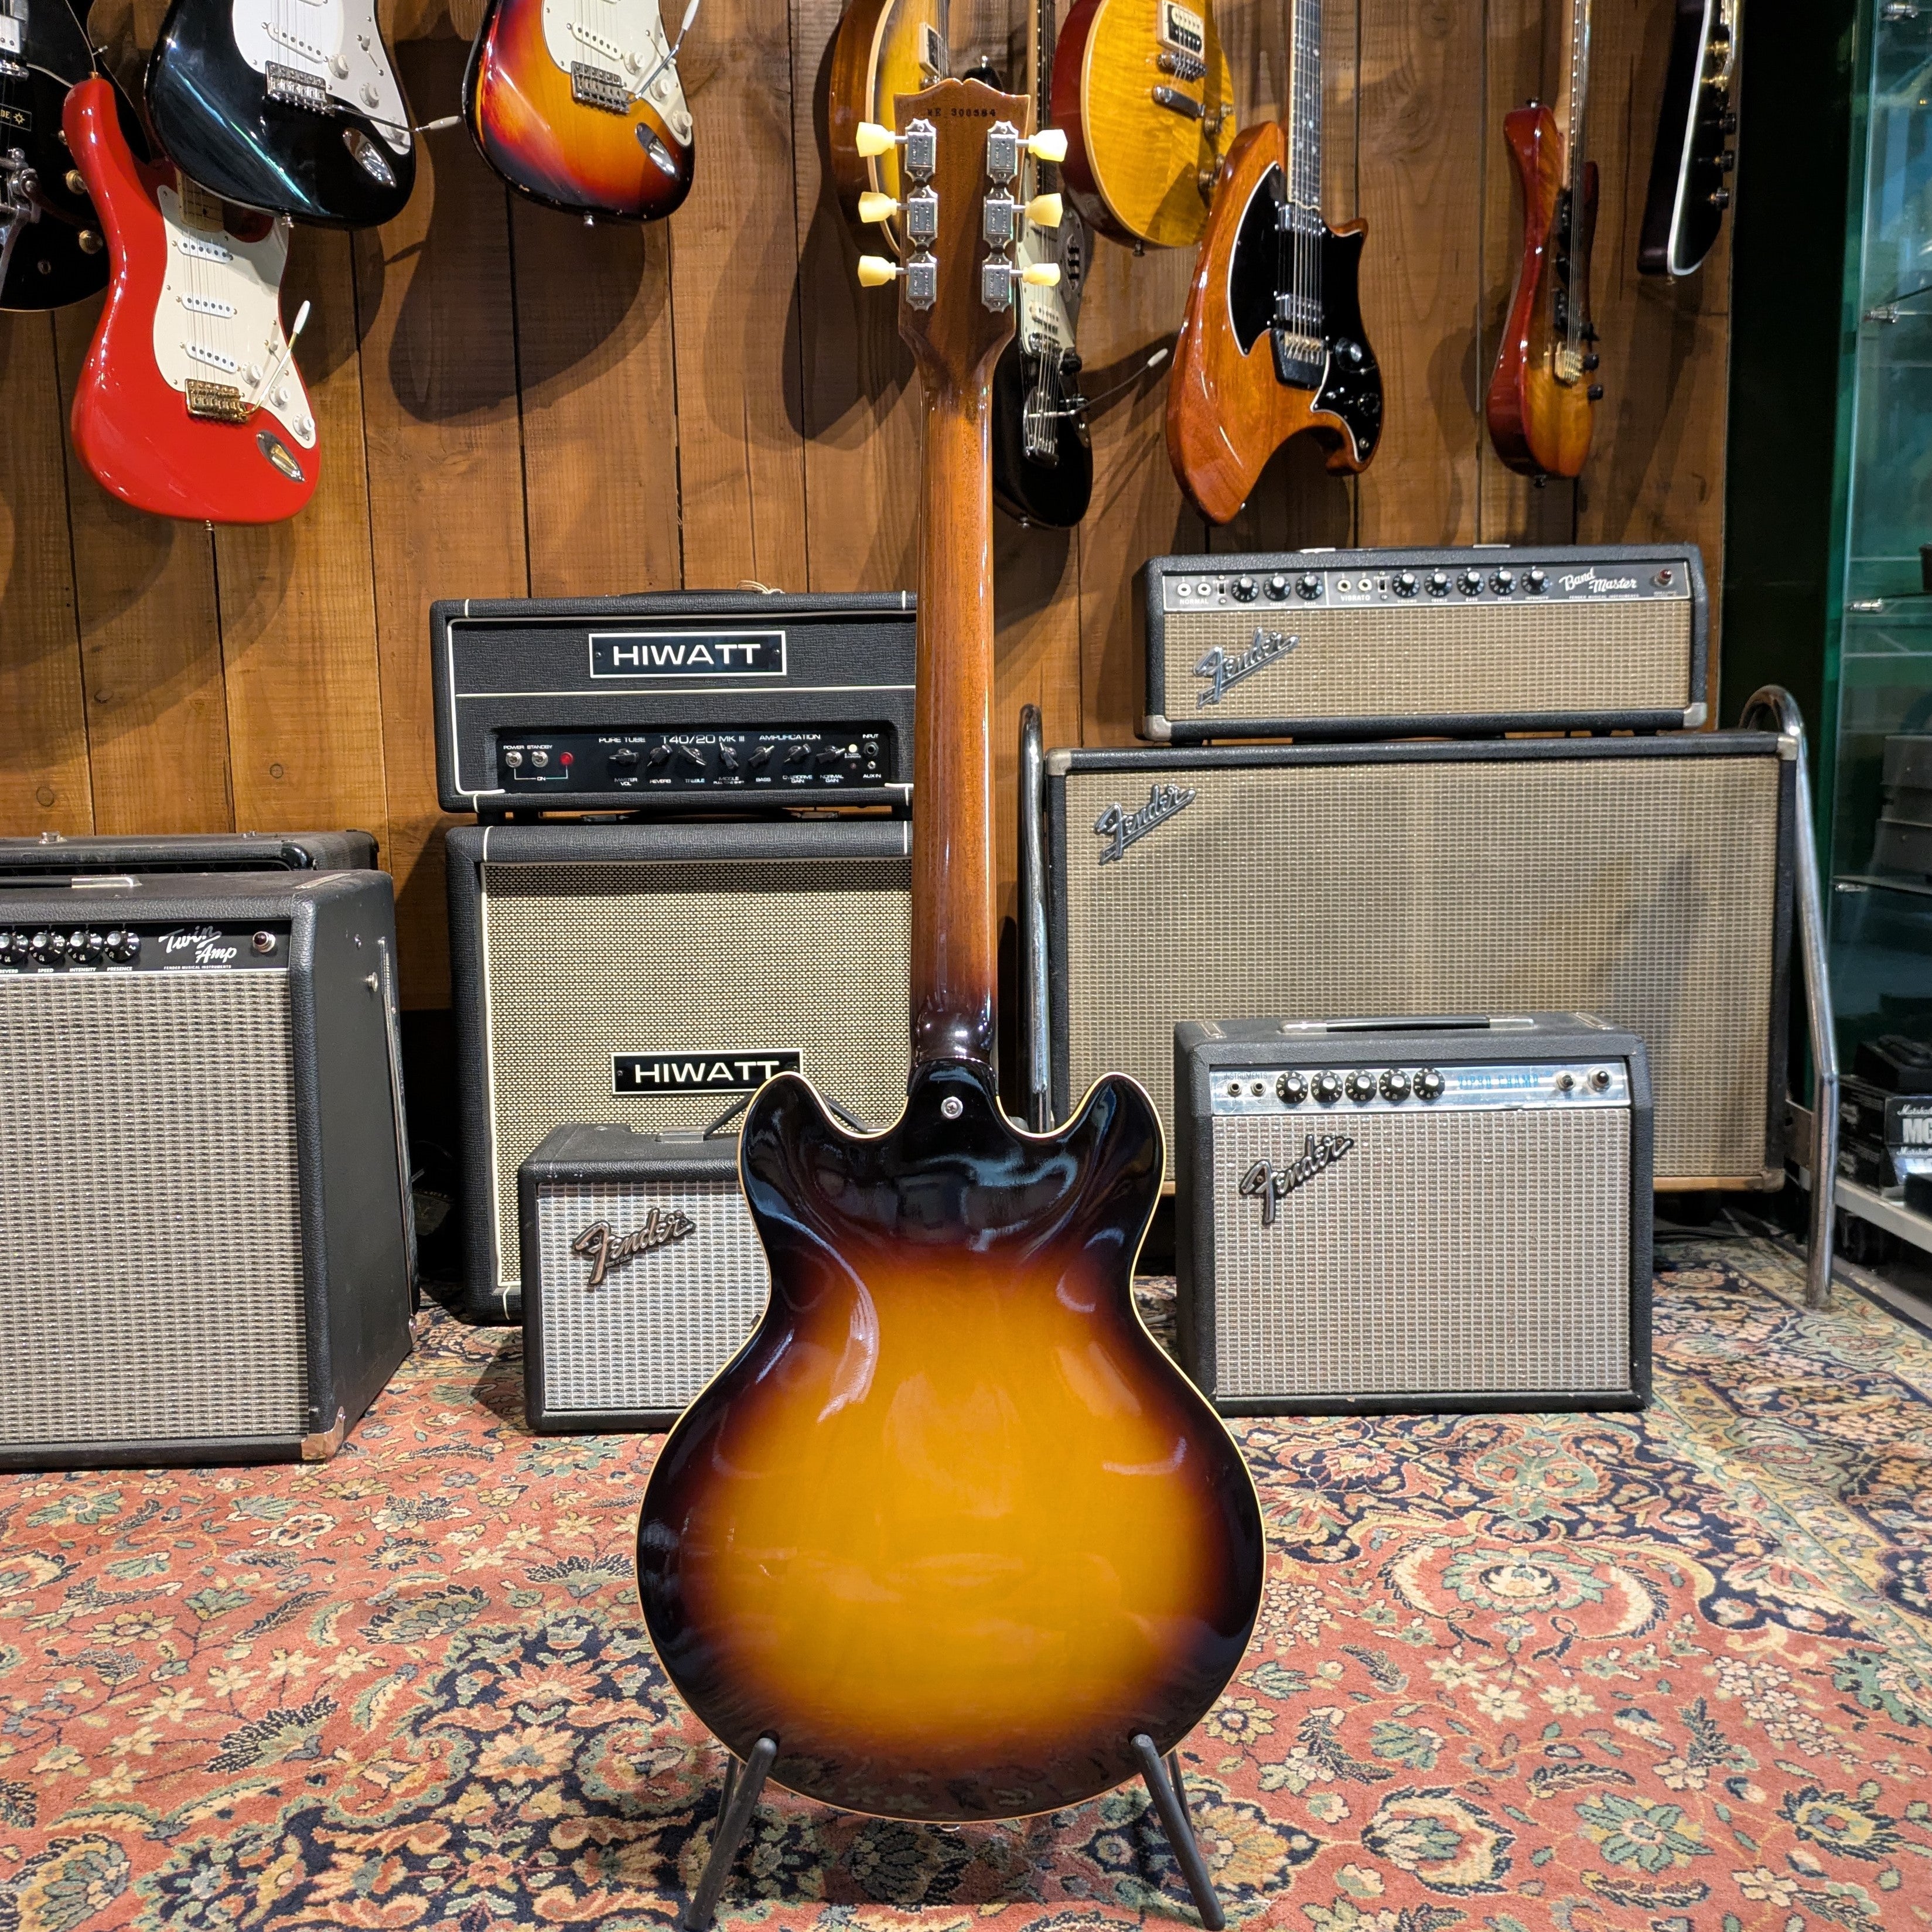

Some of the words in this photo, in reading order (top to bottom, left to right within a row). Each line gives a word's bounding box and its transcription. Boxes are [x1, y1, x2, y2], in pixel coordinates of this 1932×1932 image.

[1558, 566, 1596, 592] Band
[1588, 576, 1637, 593] Master
[613, 643, 760, 665] HIWATT
[1193, 626, 1300, 709] Fender
[660, 735, 715, 744] T40/20
[1094, 784, 1196, 866] Fender
[158, 926, 222, 953] Twin
[195, 943, 237, 963] Amp
[635, 1061, 779, 1083] HIWATT
[1239, 1135, 1354, 1225] Fender
[572, 1207, 697, 1284] Fender
